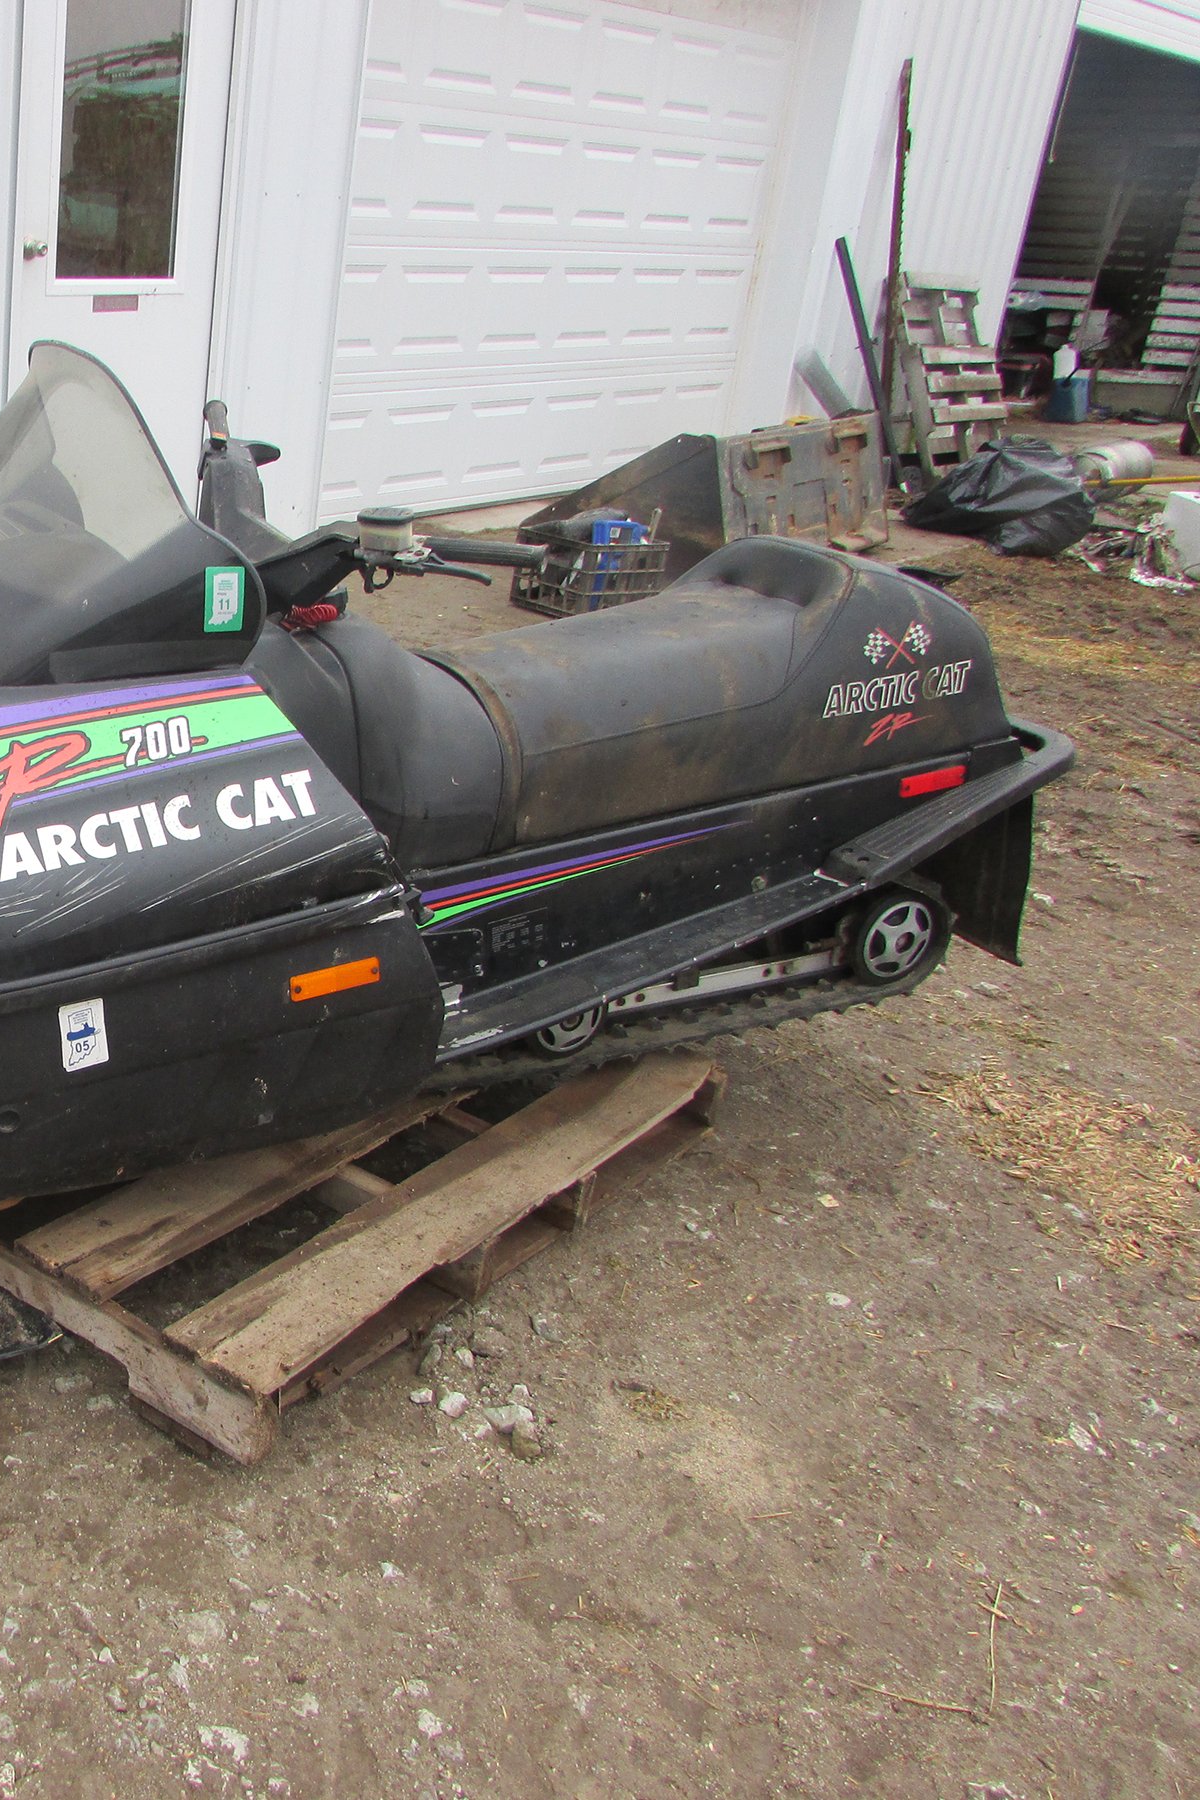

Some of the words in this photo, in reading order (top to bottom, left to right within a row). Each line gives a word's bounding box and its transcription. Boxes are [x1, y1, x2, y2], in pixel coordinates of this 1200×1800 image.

[218, 599, 230, 610] 11
[823, 671, 920, 718] ARCTIC
[922, 660, 972, 700] CAT
[120, 716, 192, 768] 700
[0, 795, 201, 882] ARCTIC
[215, 769, 317, 830] CAT
[75, 1040, 90, 1053] 05
